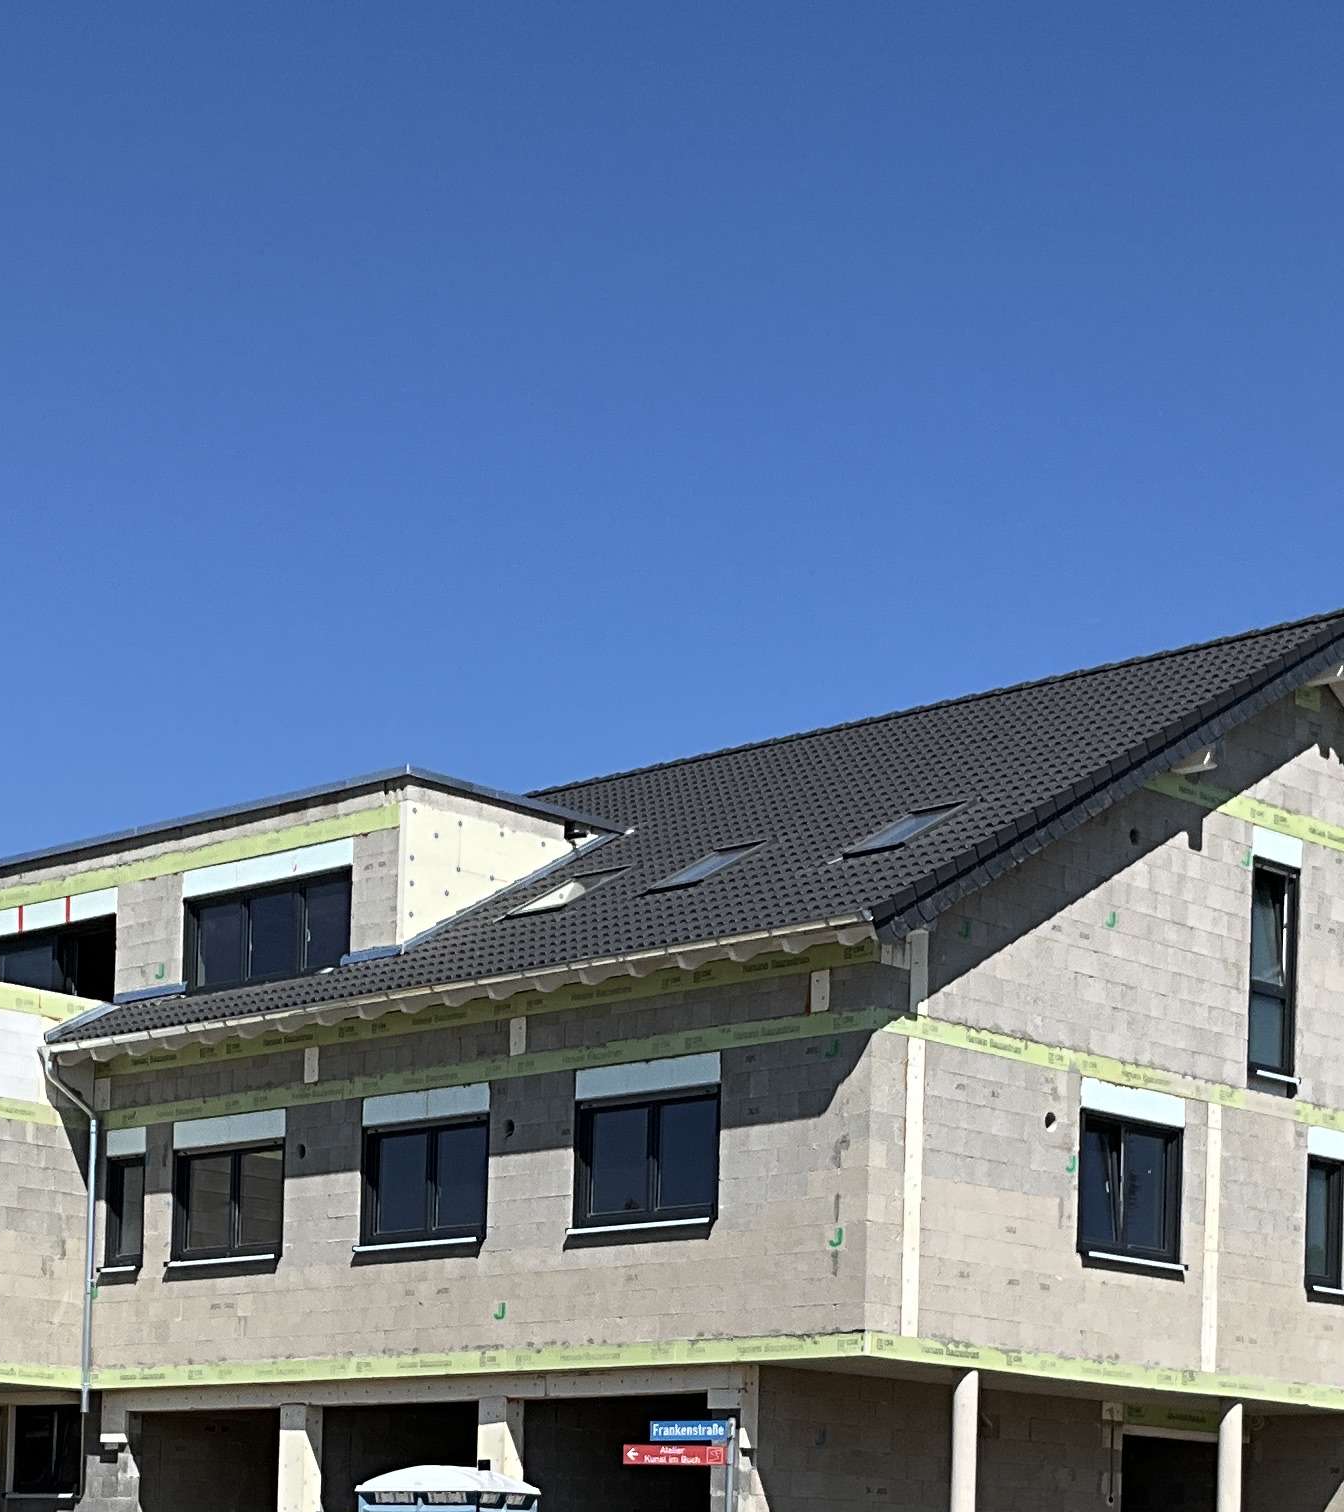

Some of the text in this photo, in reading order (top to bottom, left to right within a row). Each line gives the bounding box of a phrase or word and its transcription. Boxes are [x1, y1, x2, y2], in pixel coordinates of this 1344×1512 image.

[652, 1422, 725, 1437] Frankenstraße
[643, 1454, 667, 1464] Kunst
[669, 1455, 679, 1463] im
